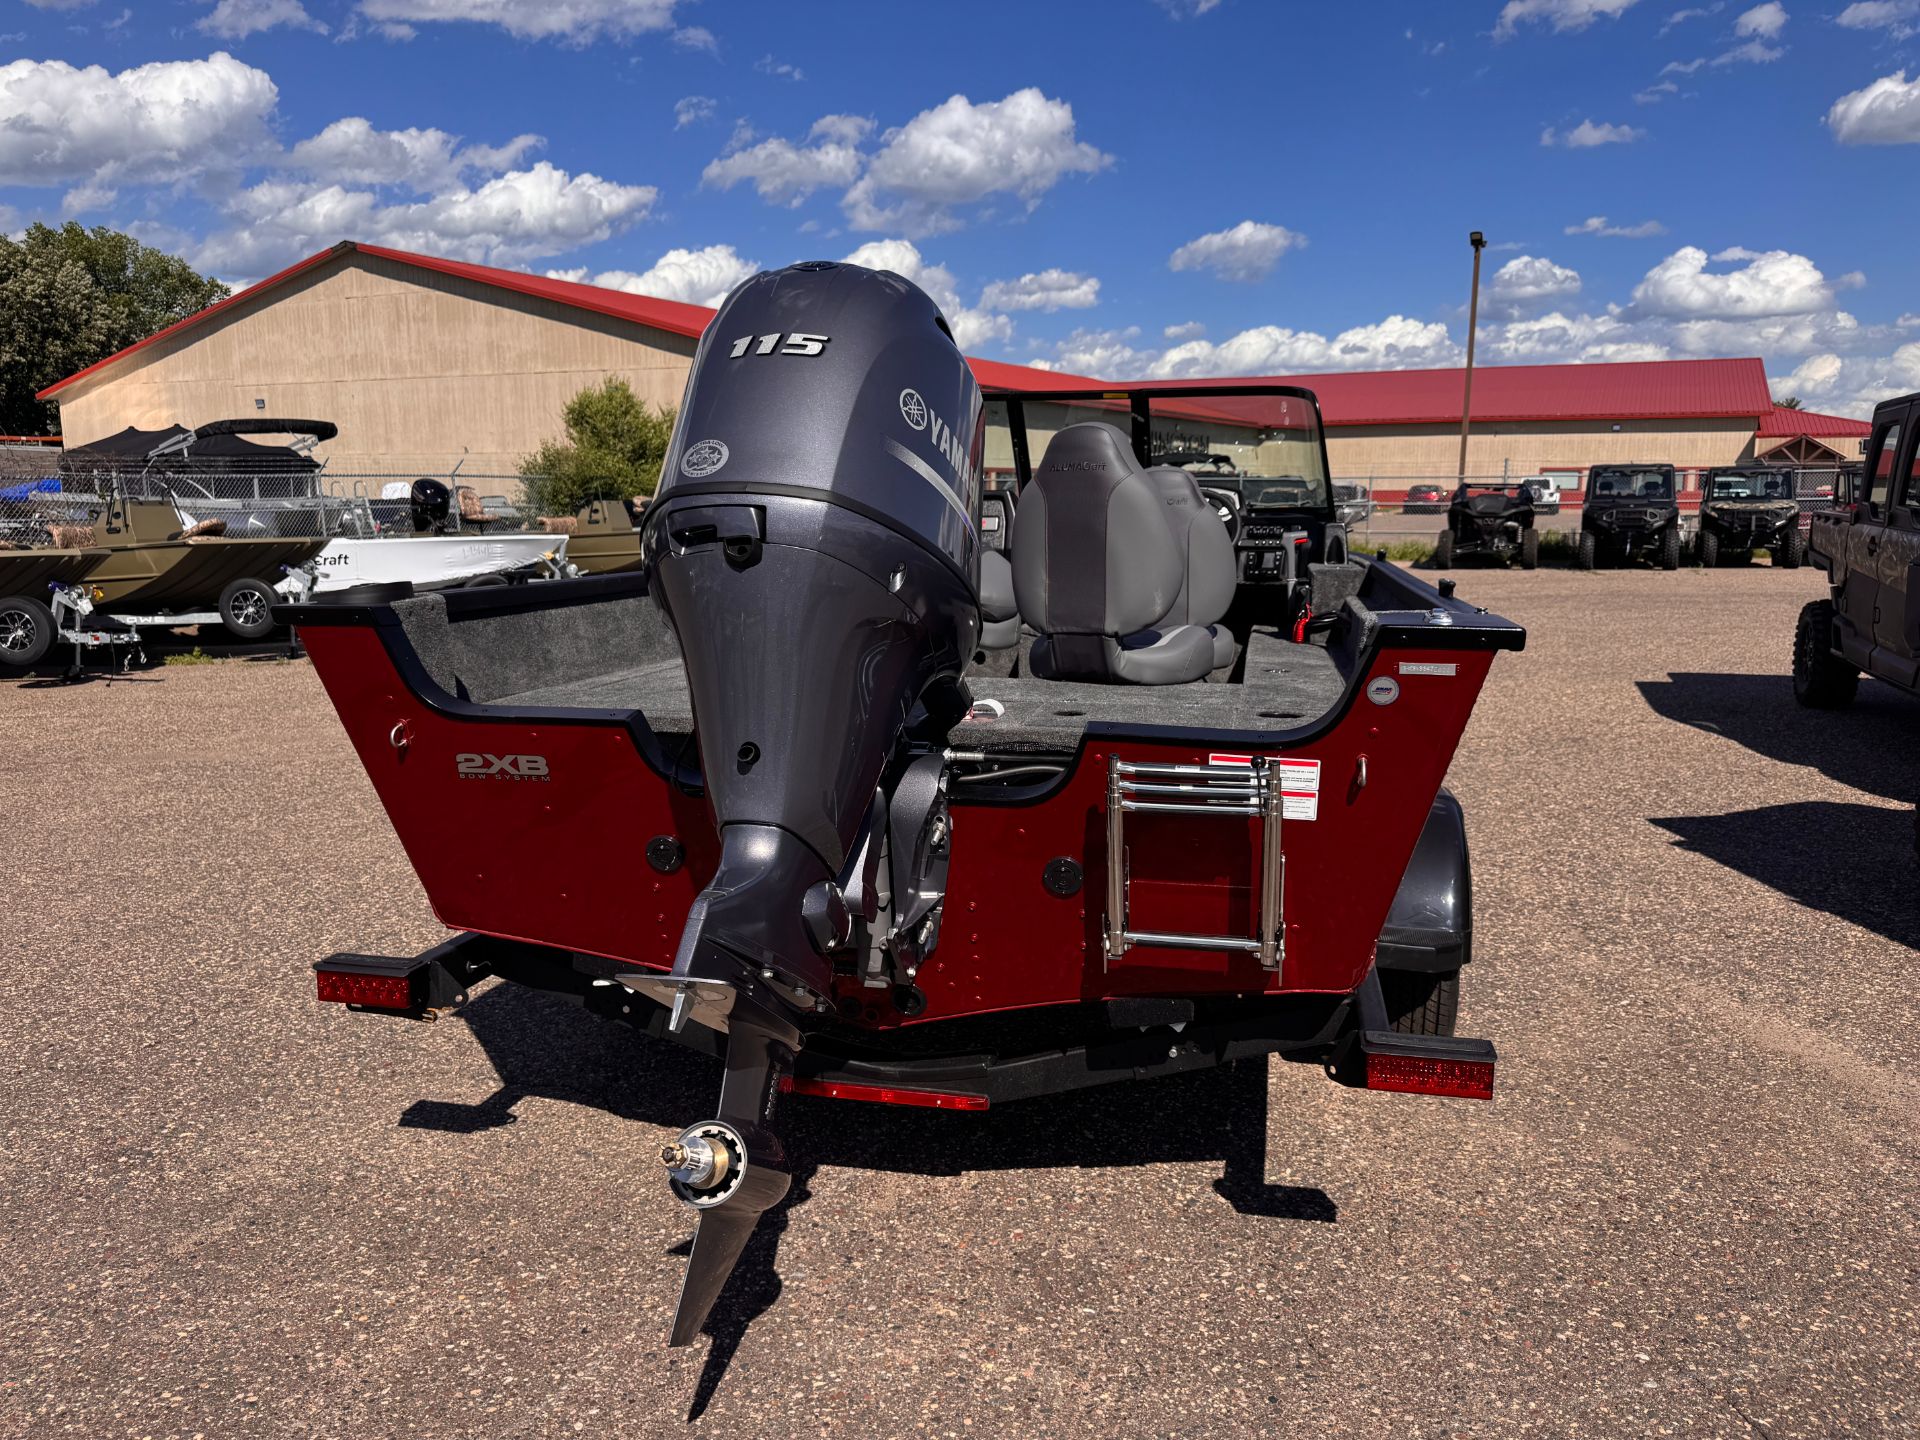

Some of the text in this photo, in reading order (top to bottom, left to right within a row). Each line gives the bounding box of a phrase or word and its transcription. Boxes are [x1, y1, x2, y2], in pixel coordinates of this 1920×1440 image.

[730, 333, 829, 358] 115
[456, 753, 549, 776] 2XB
[495, 774, 551, 782] SYSTEM
